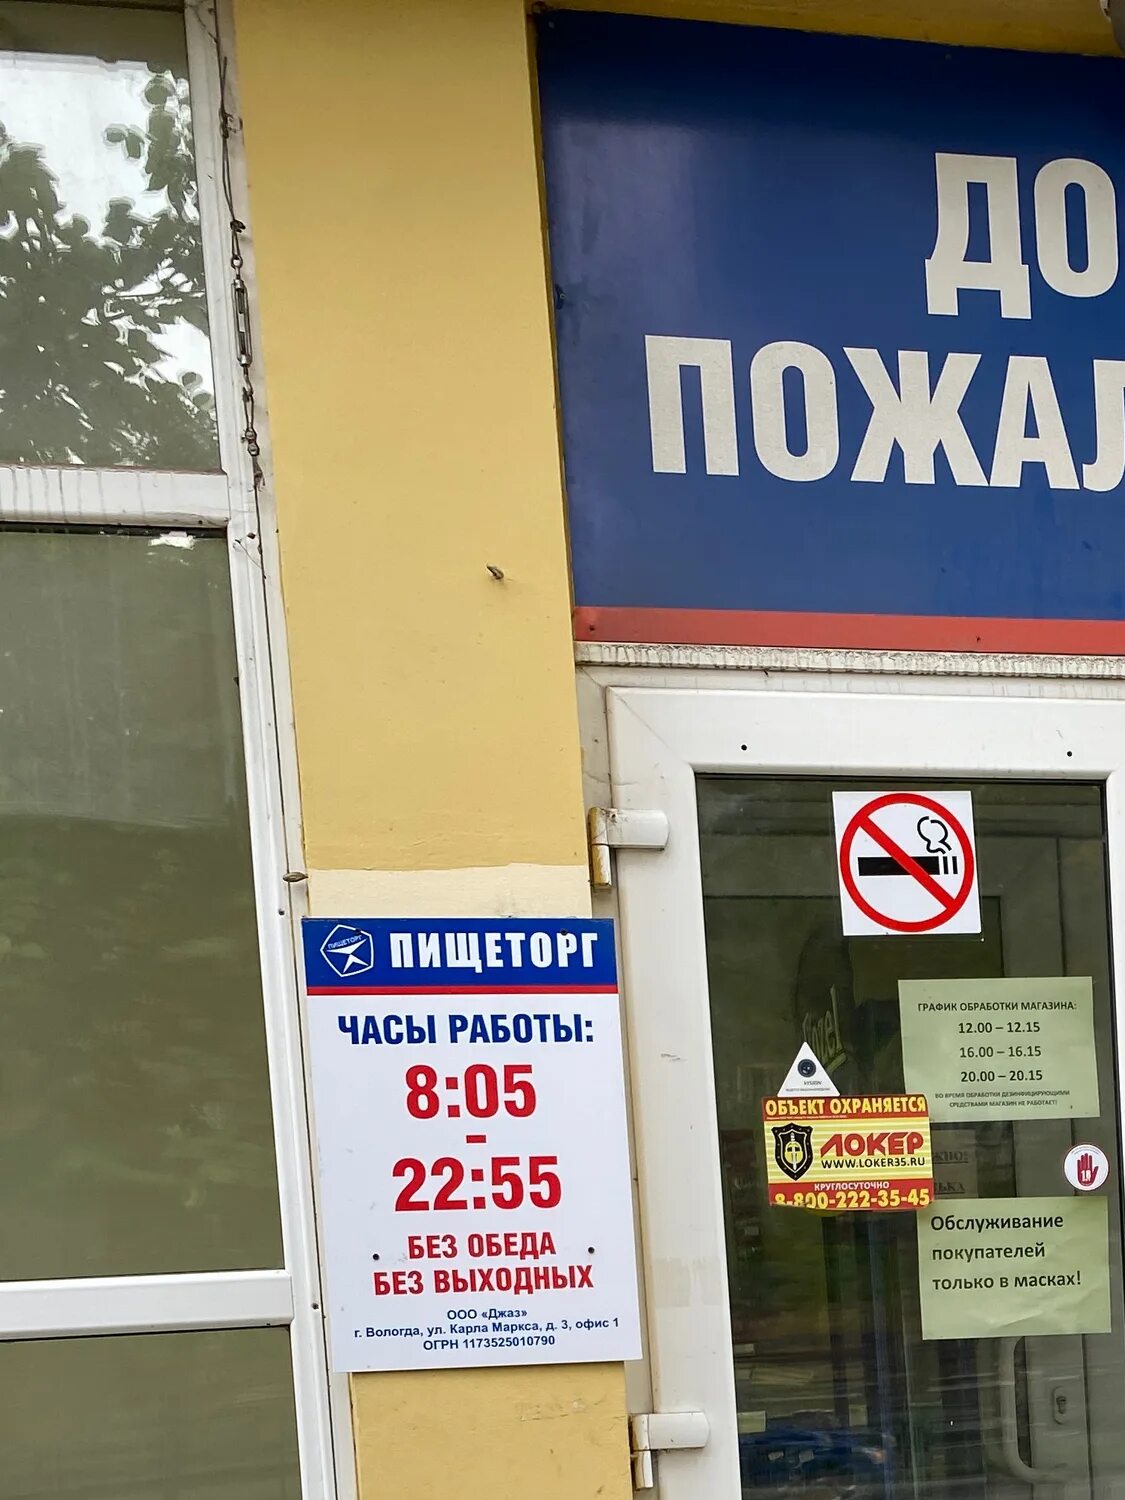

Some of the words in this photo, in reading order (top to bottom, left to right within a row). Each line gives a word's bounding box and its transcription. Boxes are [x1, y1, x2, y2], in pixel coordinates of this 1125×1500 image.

[327, 934, 363, 950] ПИЩЕТОРГ
[389, 932, 598, 974] ПИЩЕТОРГ
[917, 1002, 958, 1012] ГРАФИК
[959, 1001, 1019, 1012] ОБРАБОТКИ
[1020, 1001, 1077, 1011] МАГАЗИНА:
[338, 1015, 437, 1045] ЧАСЫ
[448, 1013, 594, 1043] РАБОТЫ:
[958, 1022, 993, 1034] 12.00
[1006, 1021, 1041, 1033] 12.15
[959, 1046, 994, 1058] 16.00
[1008, 1045, 1042, 1057] 16.15
[960, 1071, 995, 1083] 20.00
[1009, 1069, 1043, 1082] 20.15
[405, 1064, 537, 1119] 8:05
[765, 1099, 825, 1116] ОБЪЕКТ
[830, 1096, 926, 1114] ОХРАНЯЕТСЯ
[820, 1131, 924, 1158] ЛОКЕР
[821, 1157, 926, 1169] WWW.LOKER35.RU
[391, 1155, 562, 1212] 22:55
[814, 1181, 890, 1191] КРУГЛОСУТОЧНО
[930, 1214, 1064, 1233] Обслуживание
[408, 1234, 458, 1260] БЕЗ
[467, 1231, 557, 1260] ОБЕДА
[932, 1242, 1046, 1263] покупателей
[373, 1270, 424, 1296] БЕЗ
[433, 1265, 595, 1295] ВЫХОДНЫХ
[932, 1276, 994, 1290] только
[999, 1277, 1009, 1288] в
[1014, 1270, 1081, 1289] масках!
[446, 1308, 478, 1321] ООО
[481, 1307, 528, 1320] «Джаз»
[354, 1329, 363, 1338] г.
[366, 1326, 424, 1340] Вологда,
[427, 1326, 446, 1339] ул.
[449, 1322, 489, 1334] Карла
[492, 1320, 543, 1335] Маркса,
[546, 1321, 558, 1332] д.
[561, 1319, 573, 1331] 3,
[575, 1316, 610, 1332] офис
[612, 1317, 619, 1327] 1
[422, 1338, 460, 1351] ОГРН
[462, 1335, 556, 1350] 1173525010790
